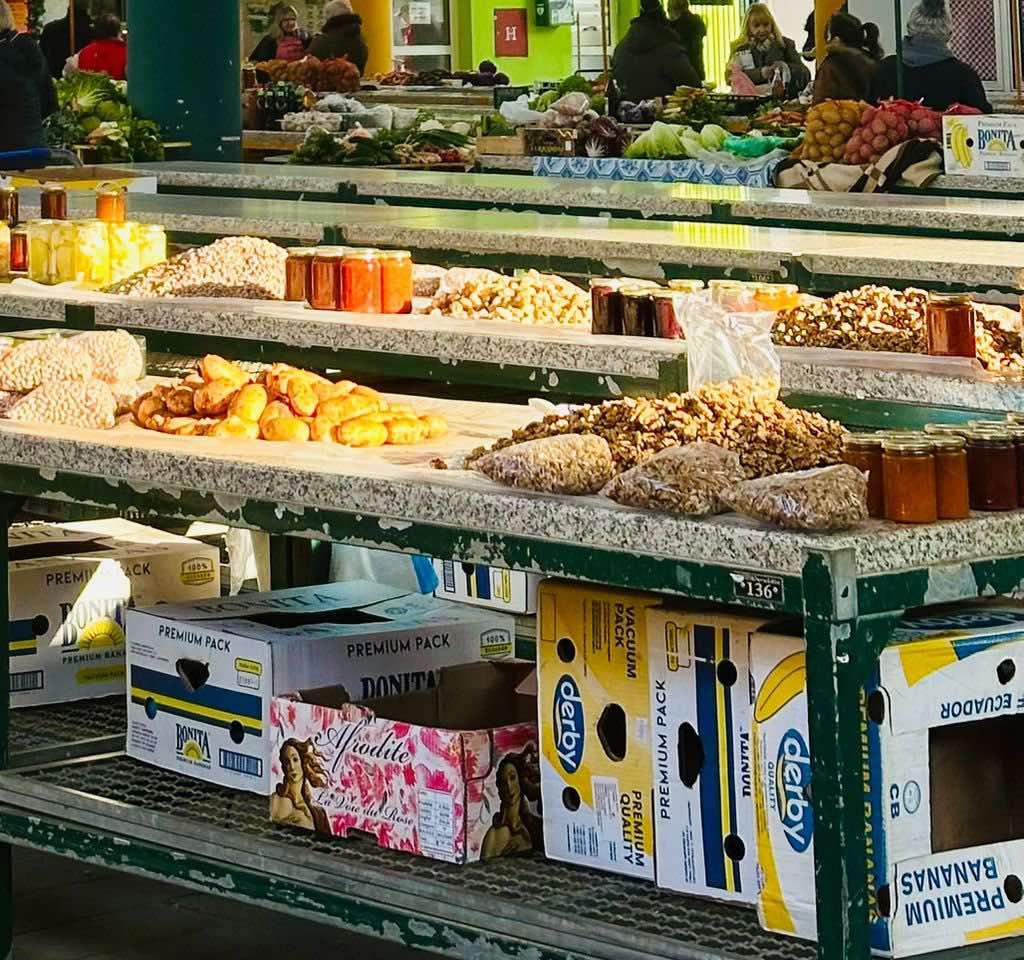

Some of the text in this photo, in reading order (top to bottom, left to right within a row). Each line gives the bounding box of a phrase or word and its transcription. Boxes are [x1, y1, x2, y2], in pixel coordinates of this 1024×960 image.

[506, 27, 517, 40] H
[978, 128, 1017, 151] BONITA
[120, 561, 151, 578] ACK
[746, 581, 773, 599] 136
[158, 624, 231, 654] PREMIUM PACK
[614, 603, 625, 648] PACK
[626, 605, 637, 678] VACUUM
[347, 633, 451, 658] PREMIUM PACK
[941, 692, 1013, 719] ECUADOR
[176, 723, 211, 759] BONITA
[557, 681, 582, 769] derby
[314, 718, 410, 774] Afrodite
[656, 680, 671, 820] PREMIUM PACK
[312, 792, 332, 808] La
[381, 806, 414, 826] Rose
[784, 736, 811, 850] derby
[621, 793, 634, 864] QUALITY
[632, 790, 645, 867] PREMIUM
[901, 857, 998, 895] BANANAS
[905, 887, 1005, 926] PREMIUM
